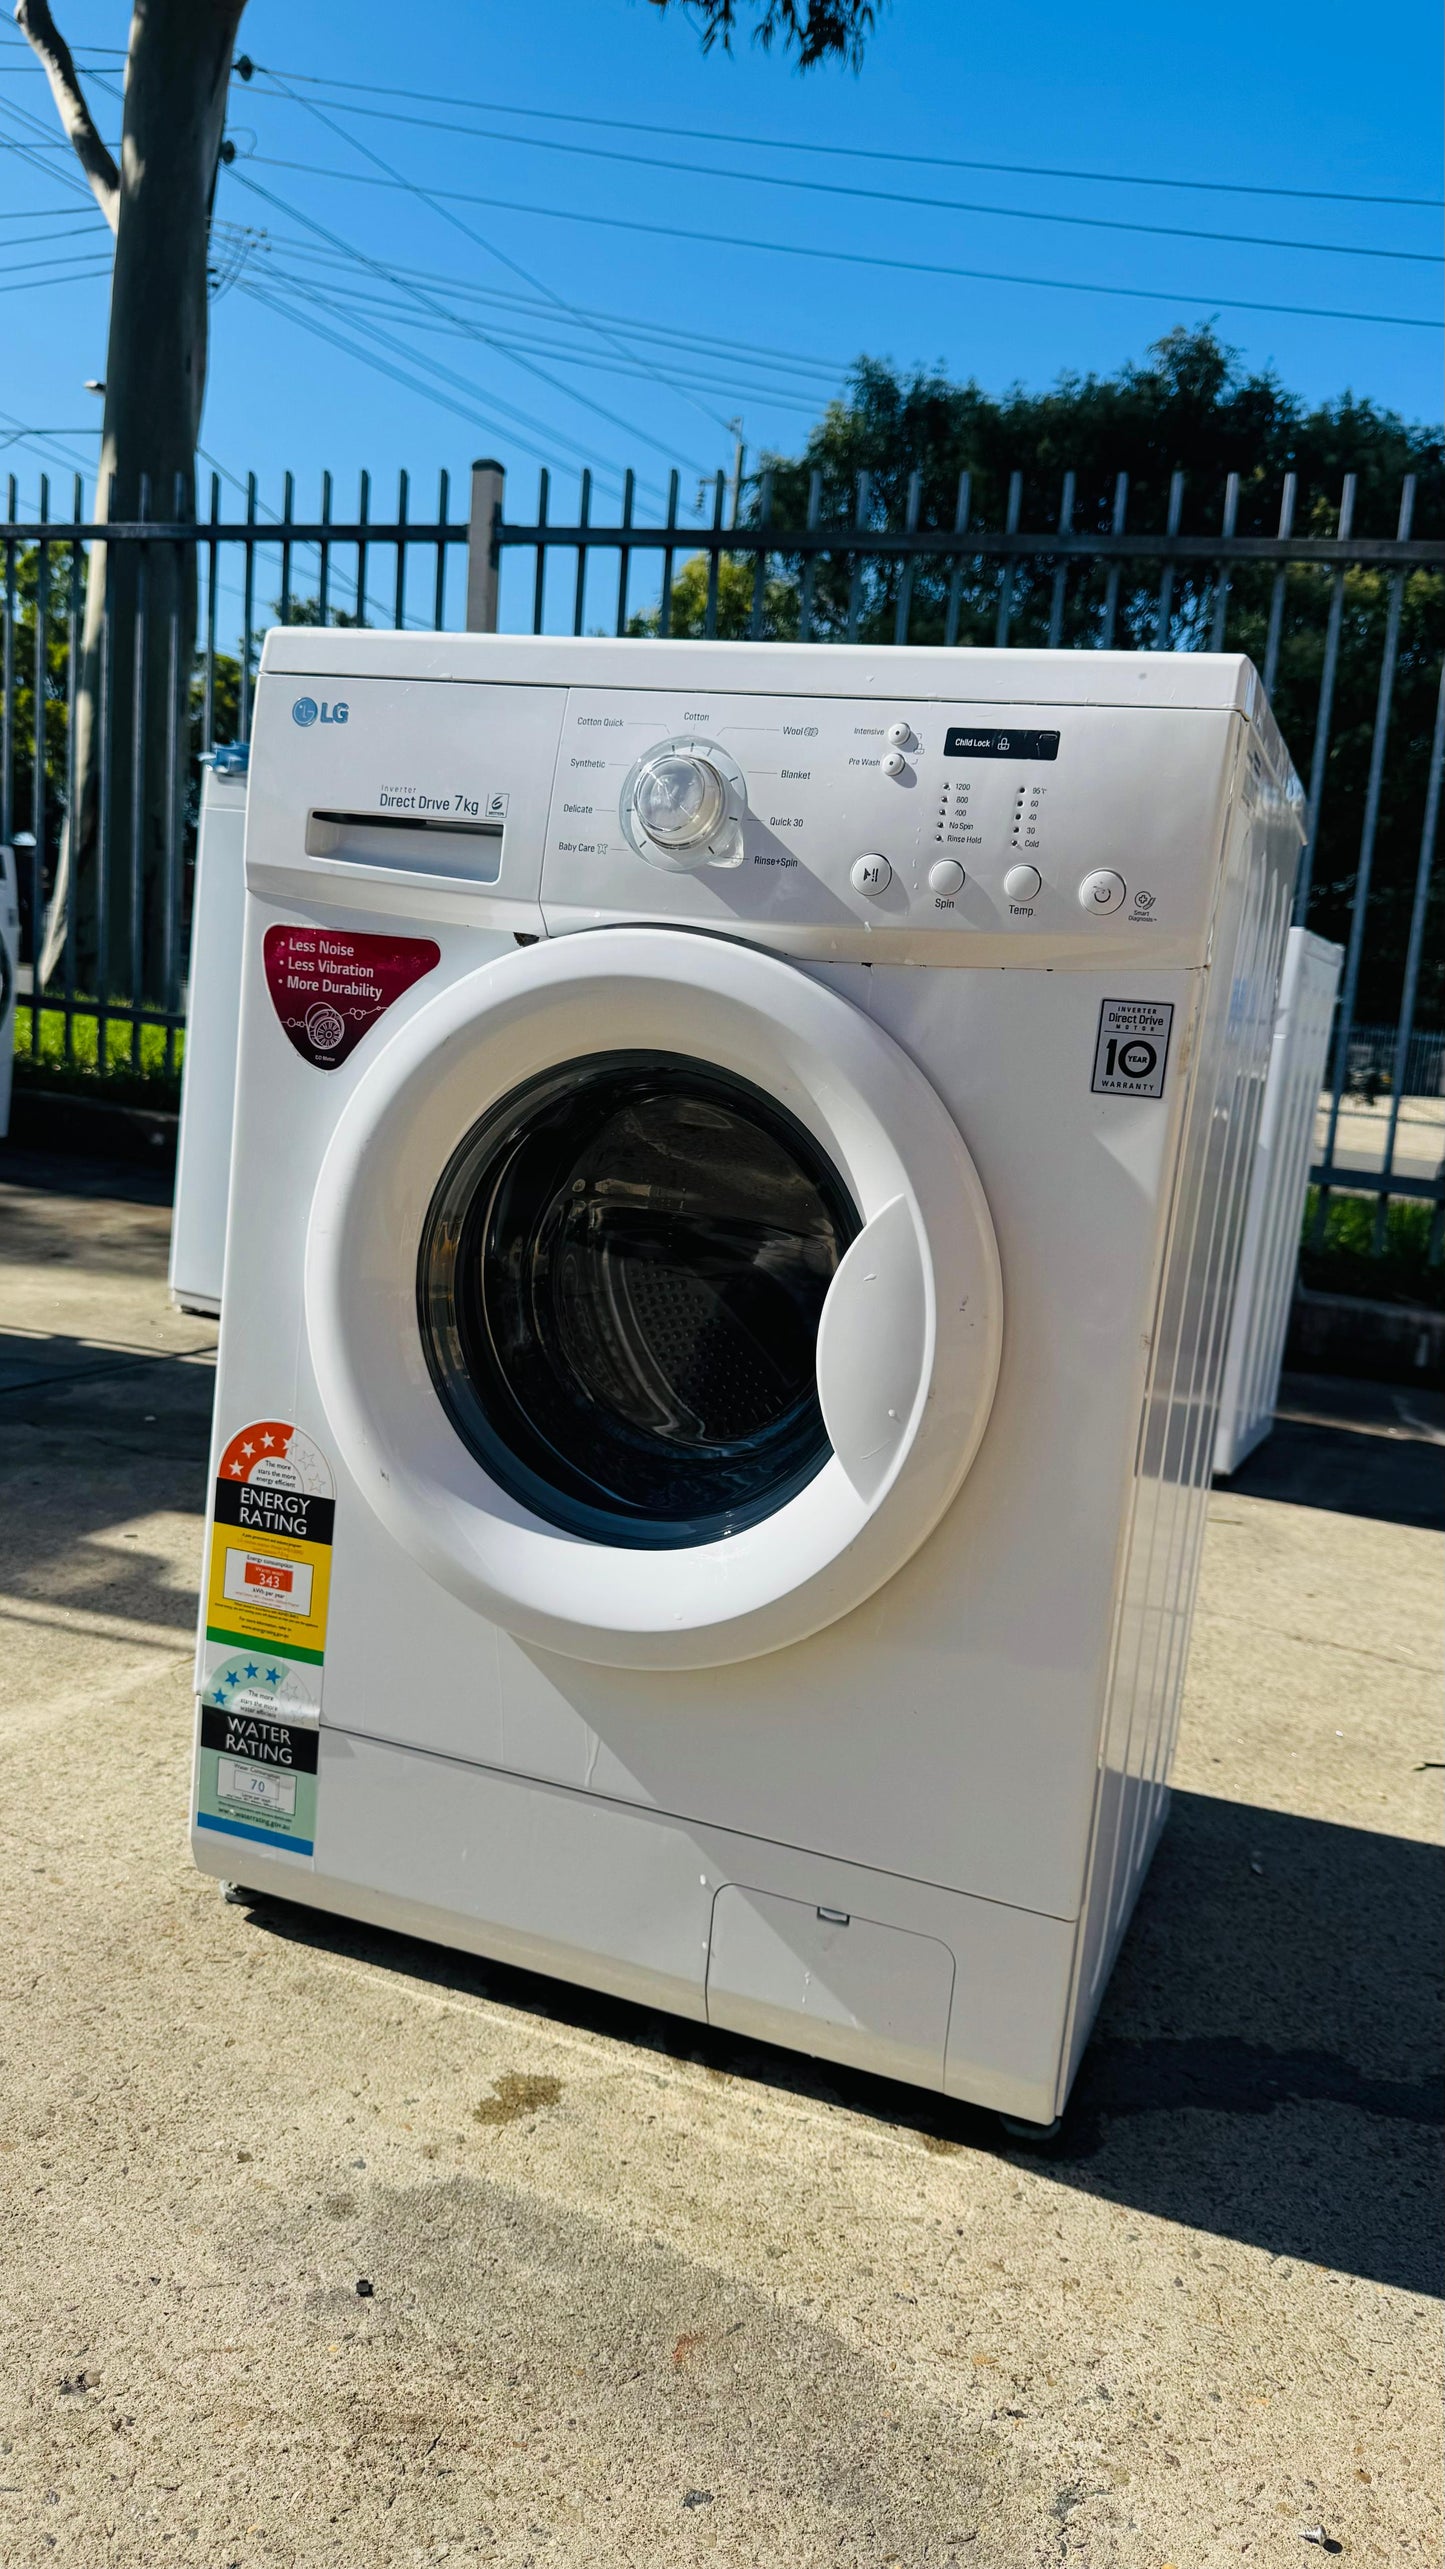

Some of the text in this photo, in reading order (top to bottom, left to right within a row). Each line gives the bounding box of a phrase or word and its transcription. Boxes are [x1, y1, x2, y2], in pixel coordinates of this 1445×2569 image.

[577, 717, 624, 728] Cotton Quick
[684, 712, 709, 722] Cotton
[782, 726, 803, 736] Wool
[854, 727, 885, 736] Intensive
[955, 738, 990, 747] Child Lock
[570, 758, 606, 769] Synthetic
[848, 758, 880, 766] Pre Wash
[781, 769, 811, 780] Blanket
[381, 784, 417, 794] Inverter
[955, 783, 971, 791] 1200
[380, 793, 415, 809] Direct
[419, 796, 450, 811] Drive
[1030, 800, 1039, 808] 60
[563, 804, 593, 814] Delicate
[769, 817, 804, 828] Quick 30
[1028, 813, 1037, 821] 40
[959, 822, 974, 831] Spin
[1026, 827, 1036, 835] 30
[966, 836, 982, 844] Hold
[558, 842, 595, 853] Baby Care
[754, 855, 799, 868] Rinse+Spin
[934, 898, 955, 910] Spin
[288, 938, 354, 956] Less Noise
[288, 956, 374, 978] Less Vibration
[287, 975, 383, 1001] More Durability
[1117, 1006, 1157, 1014] INVERTER
[1108, 1012, 1164, 1026] Direct Drive
[1106, 1038, 1157, 1079] 10
[1128, 1055, 1148, 1063] YEAR
[1101, 1080, 1155, 1091] WARRANTY
[265, 1460, 275, 1468] The
[256, 1476, 273, 1485] energy
[240, 1487, 311, 1515] ENERGY
[240, 1506, 307, 1535] RATING
[259, 1573, 280, 1588] 343
[248, 1689, 258, 1697] The
[227, 1716, 291, 1745] WATER
[225, 1734, 293, 1765] RATING
[251, 1779, 265, 1792] 70
